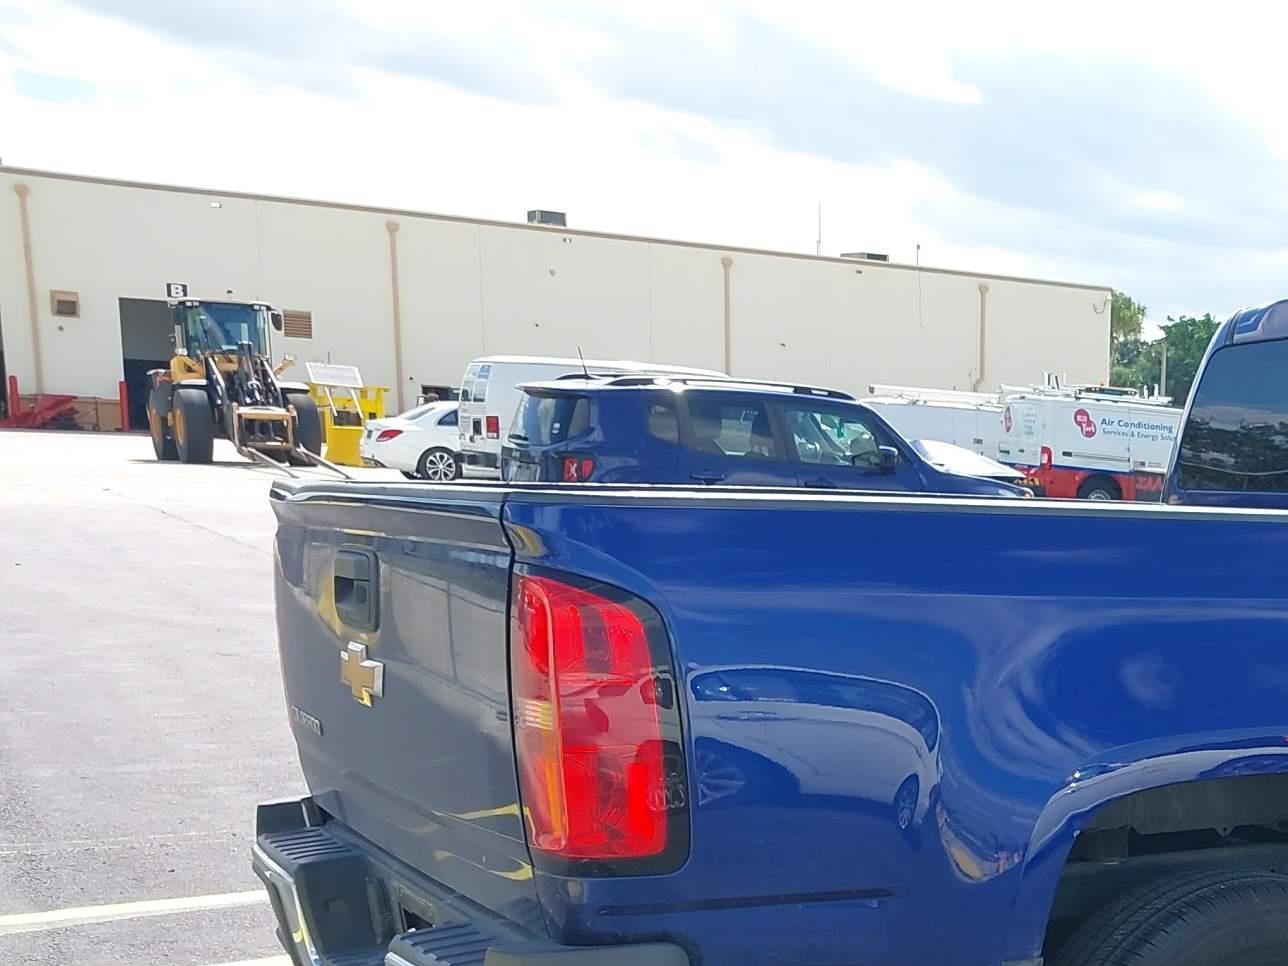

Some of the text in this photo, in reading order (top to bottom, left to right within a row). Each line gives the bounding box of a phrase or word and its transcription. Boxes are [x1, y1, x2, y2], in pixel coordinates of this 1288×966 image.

[170, 284, 184, 297] B
[1100, 418, 1174, 433] Air Conditioning
[1137, 431, 1159, 441] Energy
